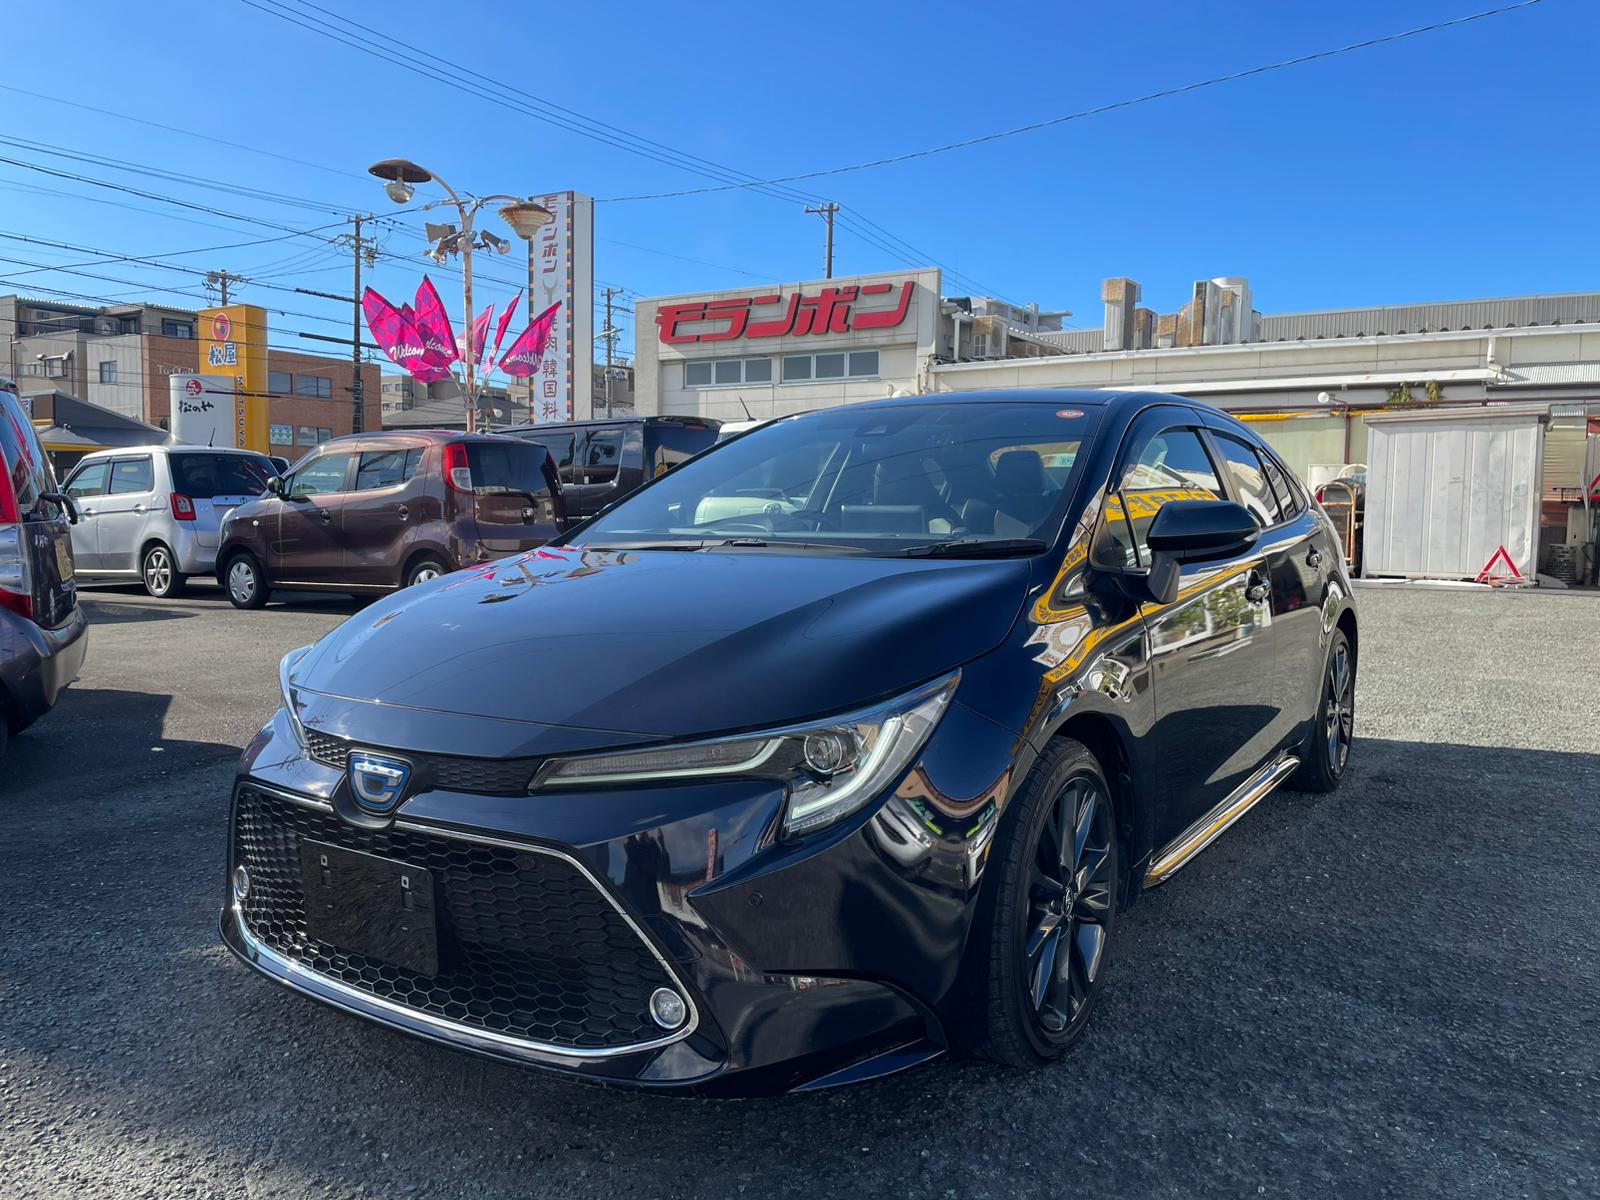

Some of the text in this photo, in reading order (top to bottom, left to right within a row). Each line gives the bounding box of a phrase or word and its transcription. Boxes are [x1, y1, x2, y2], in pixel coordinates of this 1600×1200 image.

[655, 281, 915, 344] モランボン
[208, 342, 237, 366] 松屋
[389, 343, 425, 360] Welcom
[237, 375, 246, 446] MATSUYA
